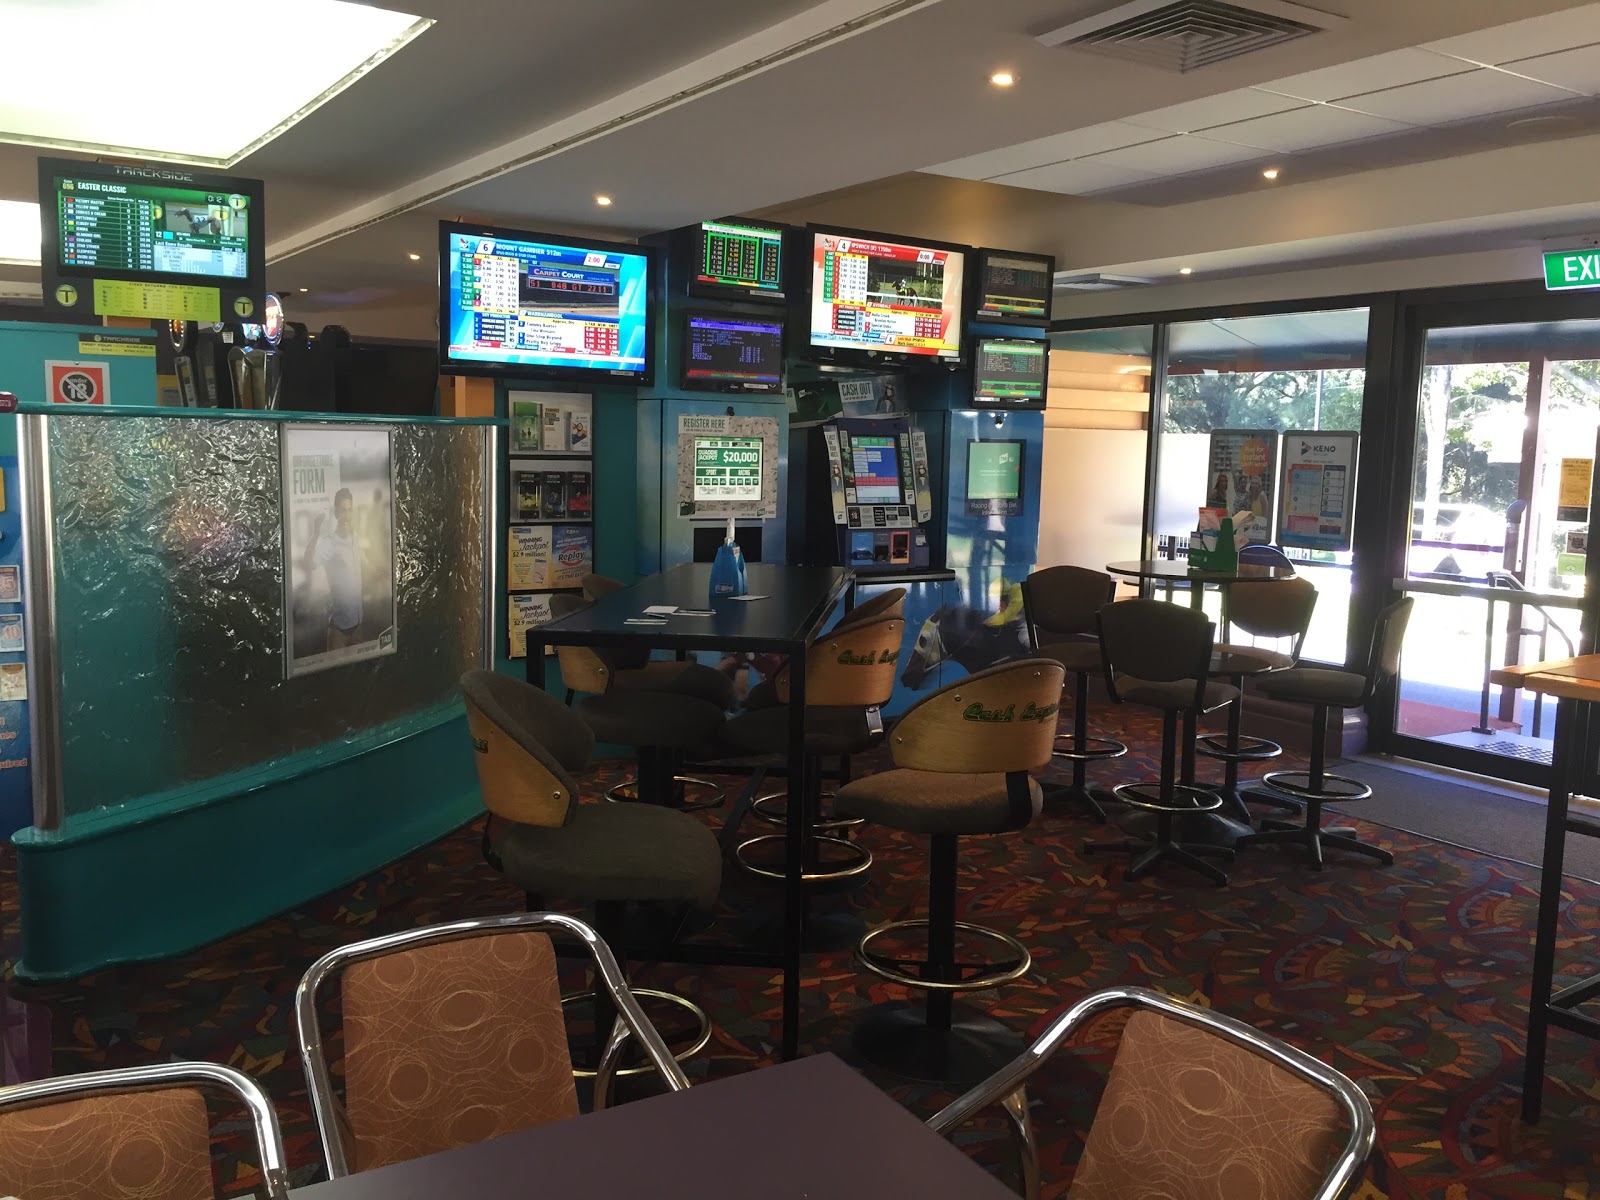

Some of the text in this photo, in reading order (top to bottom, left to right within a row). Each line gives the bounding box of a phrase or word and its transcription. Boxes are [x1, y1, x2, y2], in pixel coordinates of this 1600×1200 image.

[113, 165, 194, 182] TRACKSIDE
[77, 182, 127, 194] EASTER CLASSIC
[483, 243, 489, 251] 6
[496, 243, 518, 251] MOUNT
[518, 246, 545, 255] GAMBIER
[533, 268, 561, 277] CARPET
[561, 271, 585, 280] COURT
[1563, 254, 1600, 282] EXI
[67, 383, 88, 399] 18
[842, 382, 871, 397] CASH OUT
[683, 418, 725, 429] REGISTER HERE
[723, 450, 758, 463] $20,000
[293, 468, 325, 495] FORM
[518, 536, 543, 544] WINNING
[520, 541, 550, 552] Jackpot
[558, 551, 585, 562] Replay
[519, 603, 543, 613] WINNING
[520, 608, 550, 619] Jackpot
[380, 634, 392, 643] TAB
[837, 649, 876, 666] Cash
[963, 702, 1015, 723] Cash
